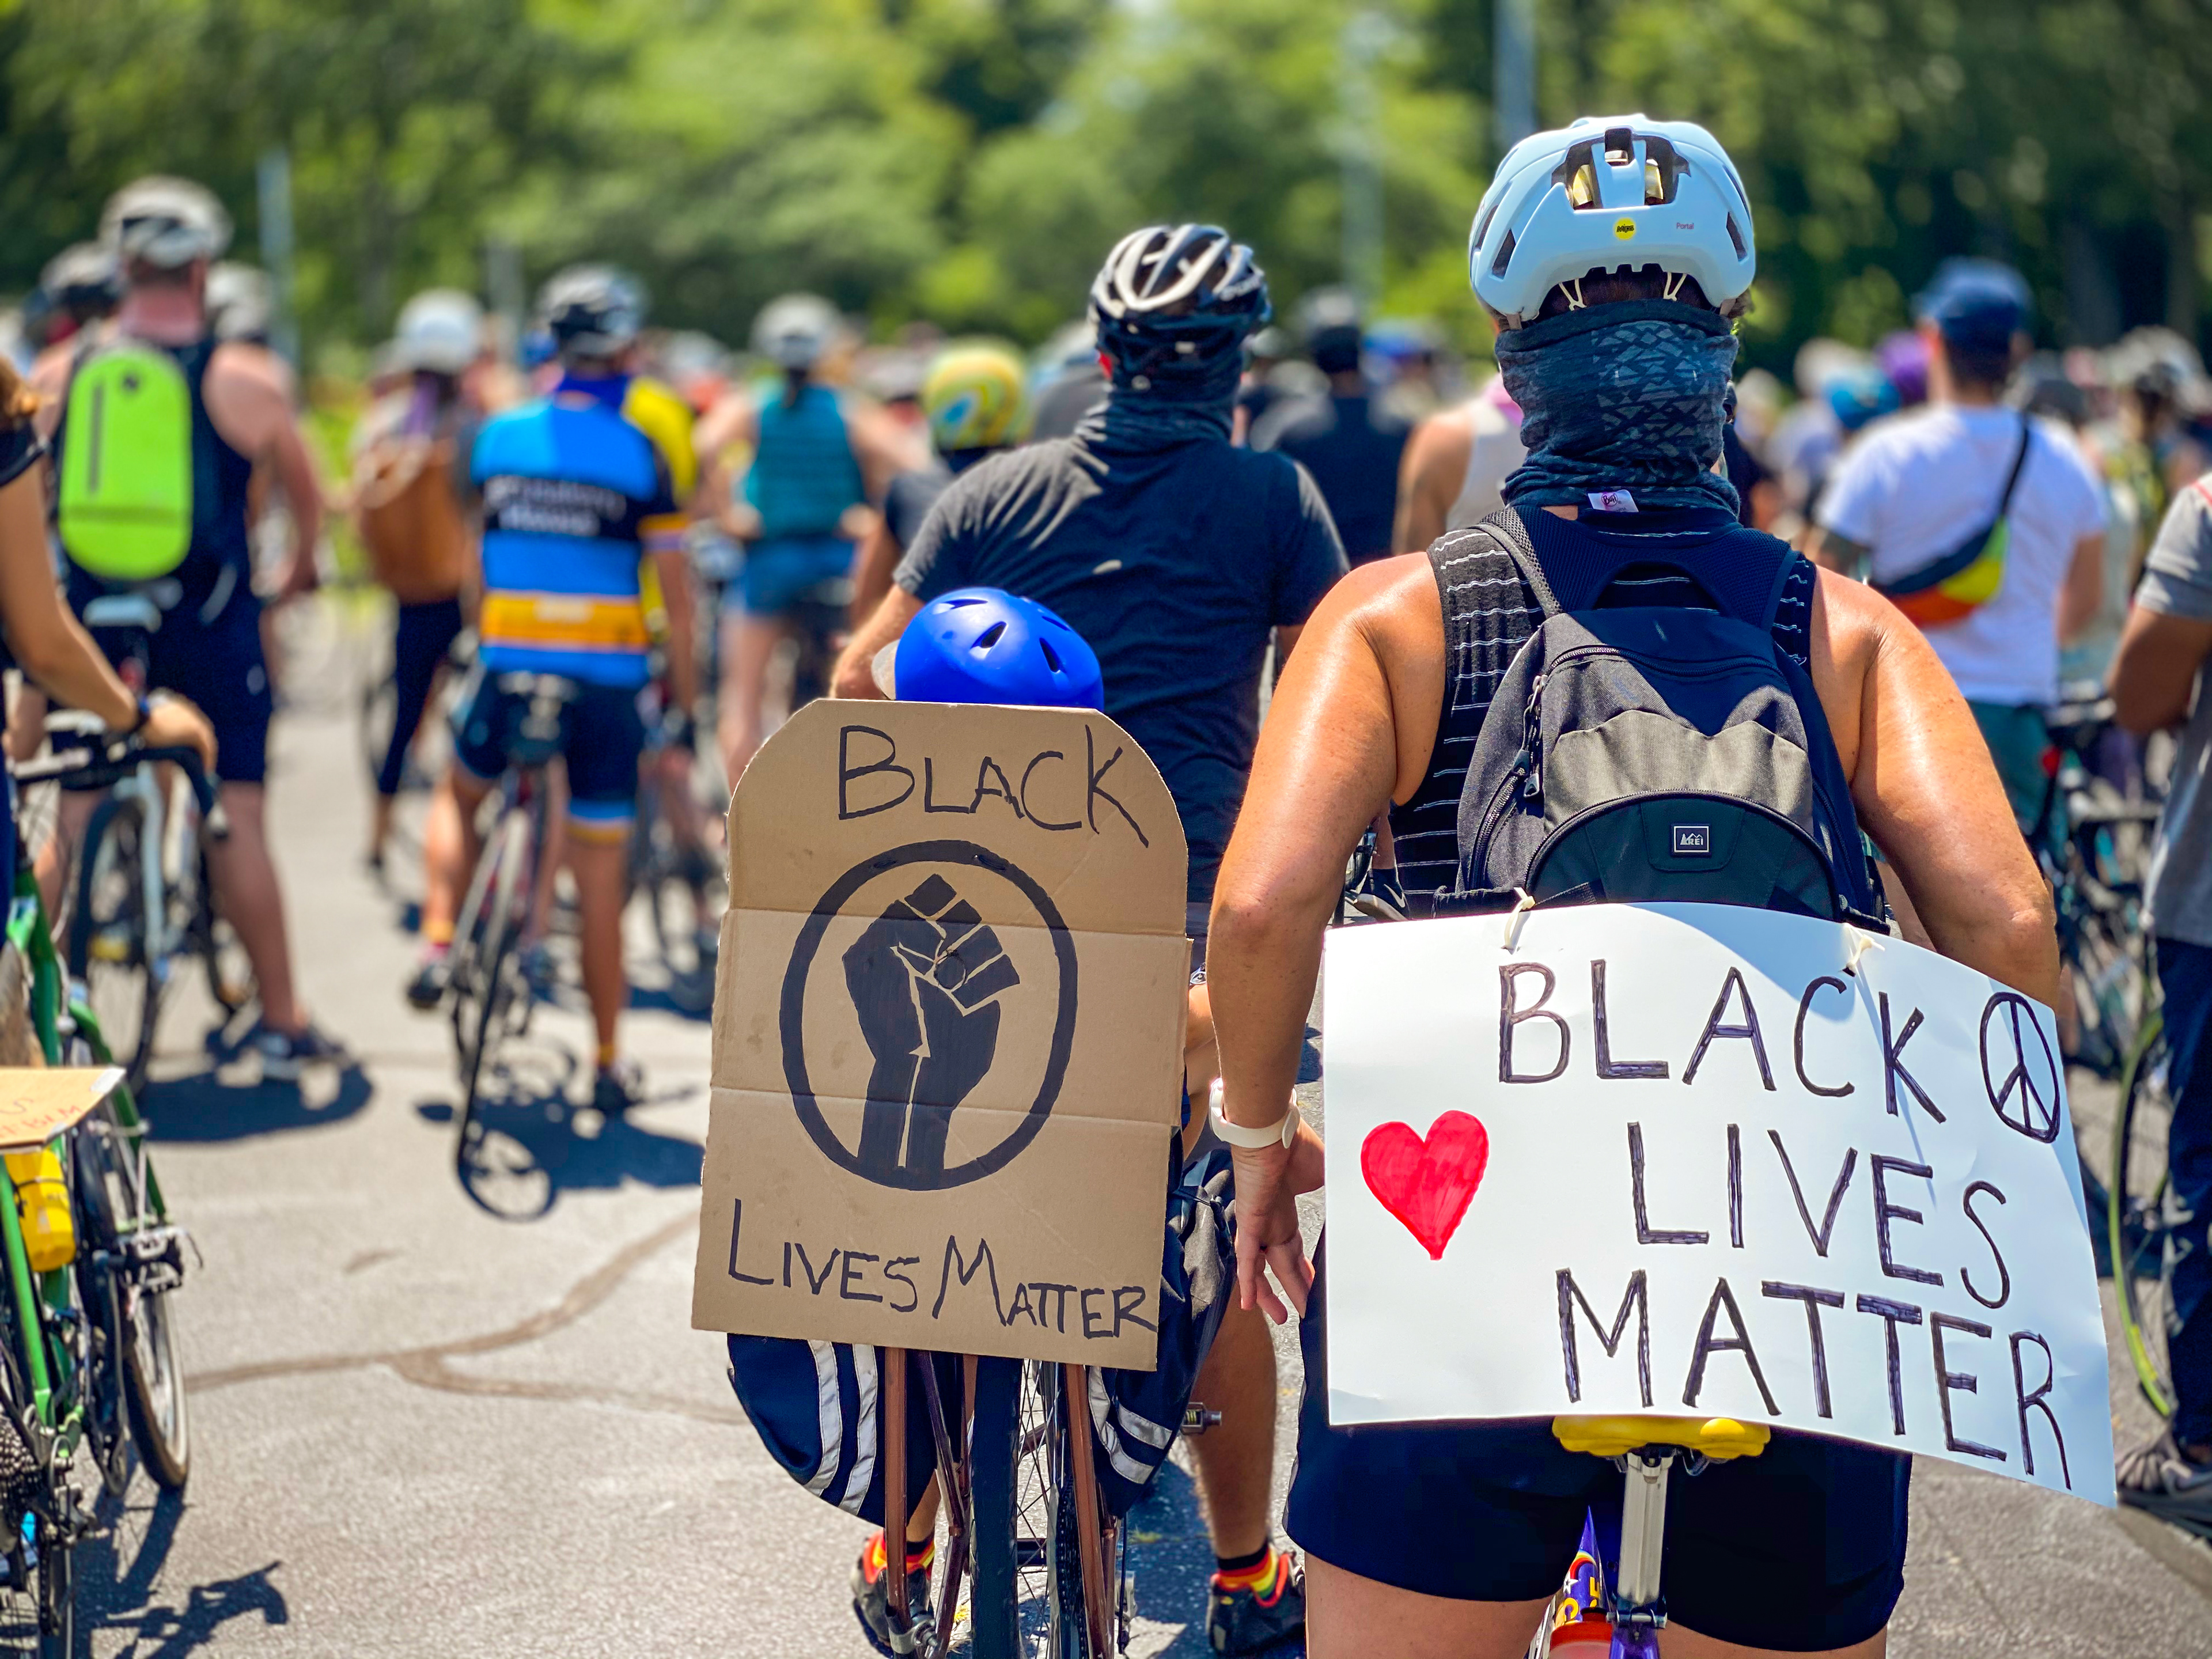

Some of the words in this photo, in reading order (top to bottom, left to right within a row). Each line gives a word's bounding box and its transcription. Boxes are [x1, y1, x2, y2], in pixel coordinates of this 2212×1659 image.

[1676, 222, 1695, 230] Portal
[839, 725, 1149, 849] BLACK
[1498, 959, 1946, 1123] BLACK
[728, 1198, 920, 1312] LIVES
[933, 1235, 1158, 1339] MATTER
[1626, 1120, 2011, 1310] LIVES
[1555, 1267, 2072, 1491] MATTER
